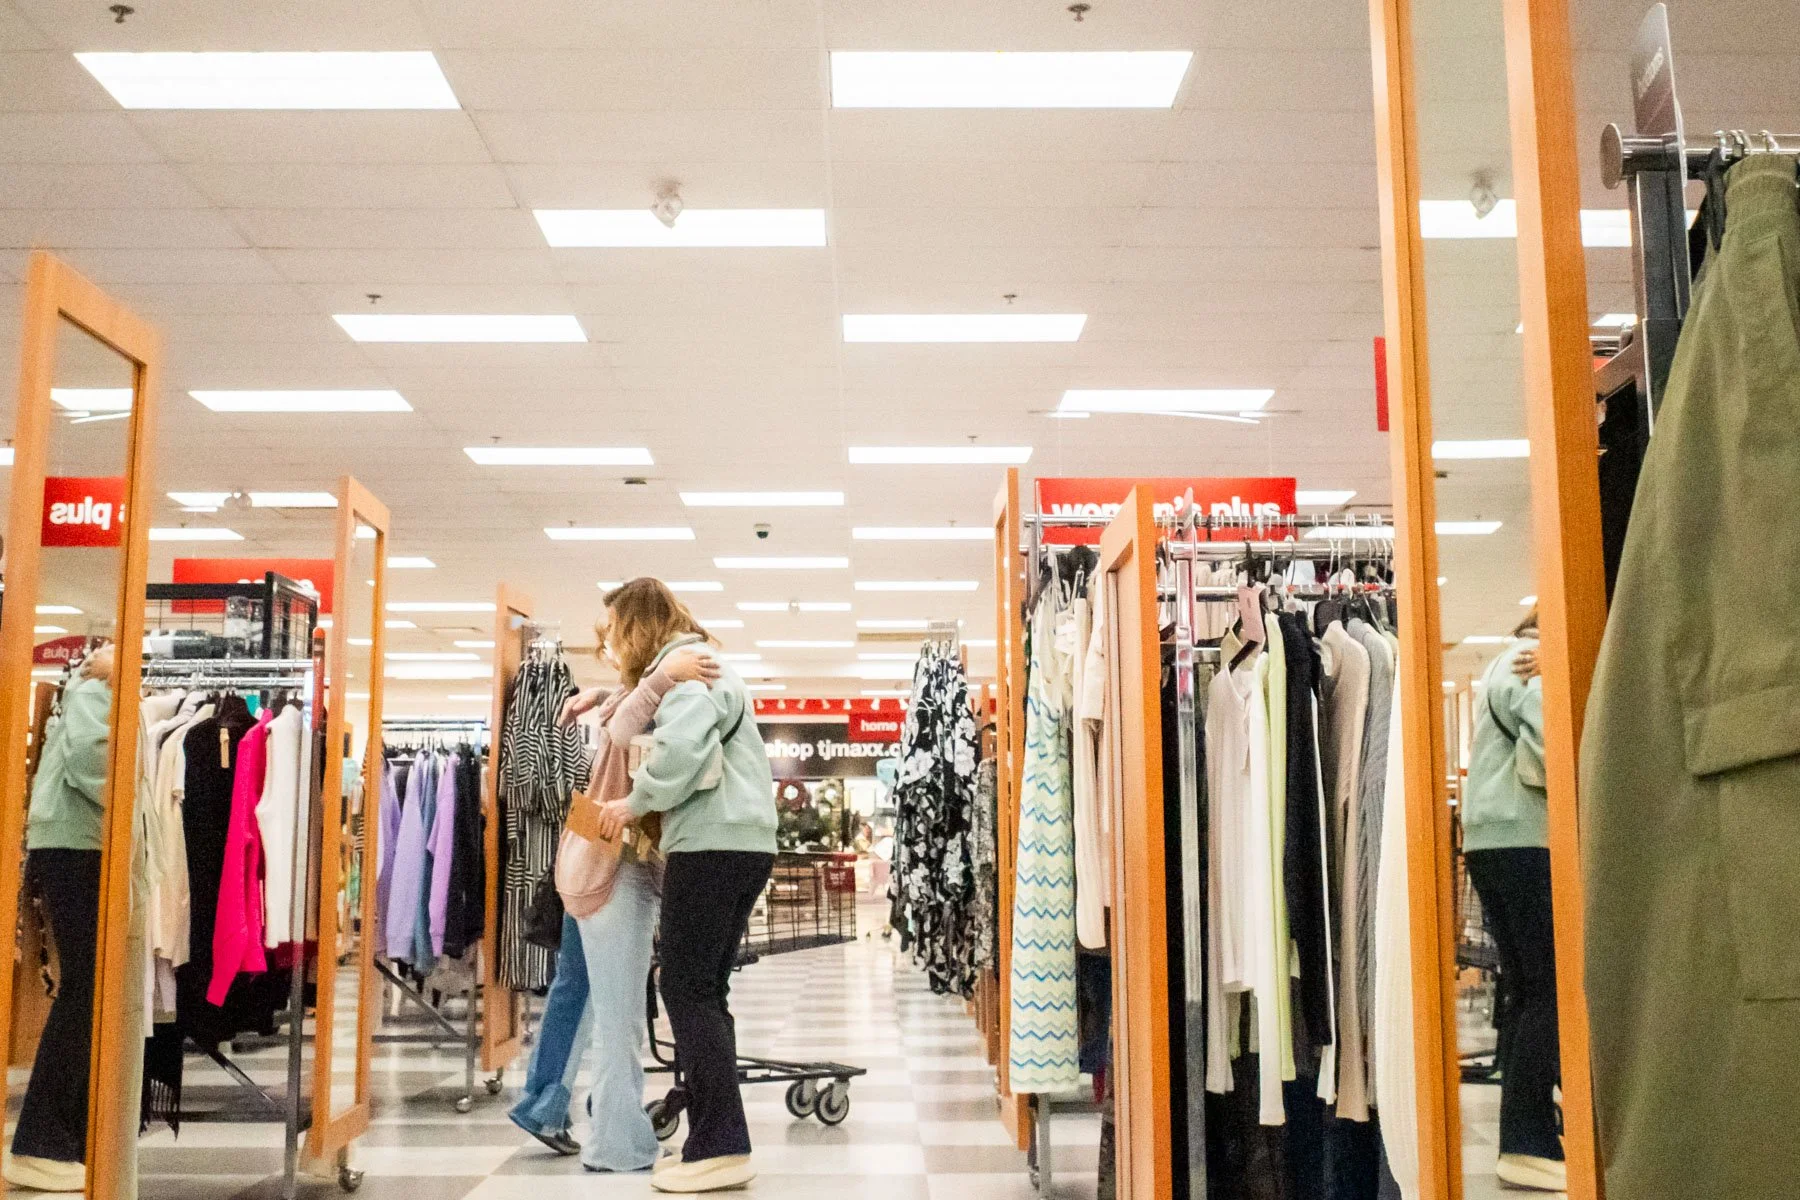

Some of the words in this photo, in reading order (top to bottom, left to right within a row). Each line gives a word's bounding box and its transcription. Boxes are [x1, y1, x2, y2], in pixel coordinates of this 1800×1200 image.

[1051, 495, 1203, 519] won'
[1211, 495, 1281, 530] plus
[860, 719, 898, 732] home
[764, 739, 815, 761] shop
